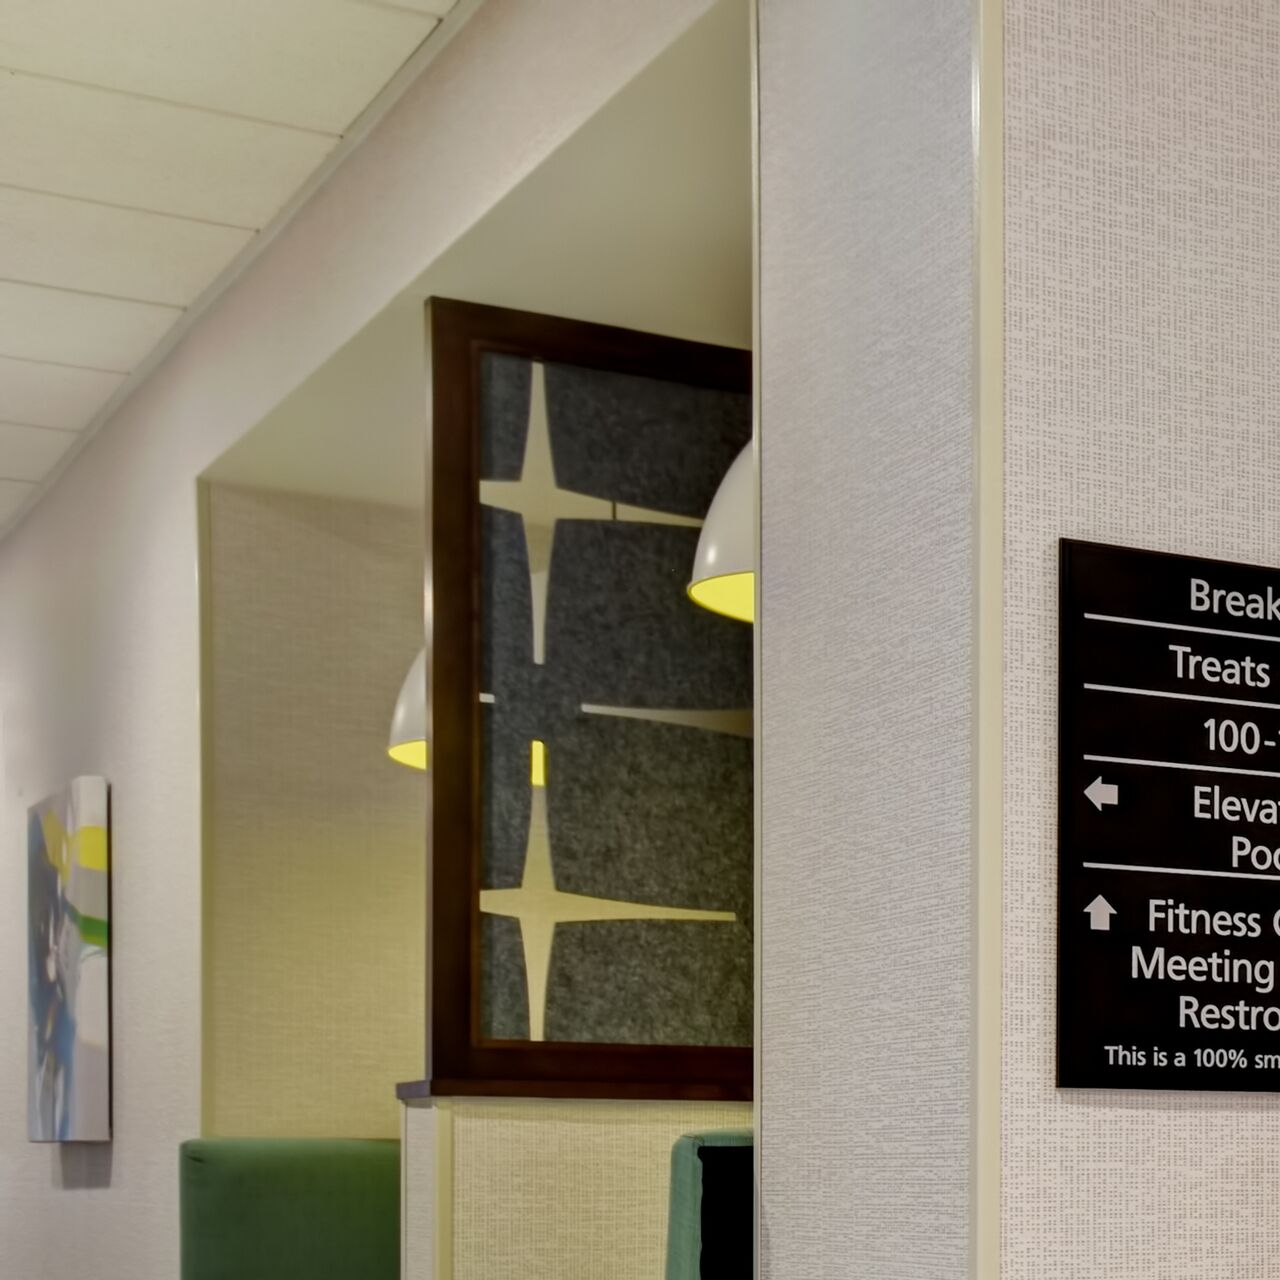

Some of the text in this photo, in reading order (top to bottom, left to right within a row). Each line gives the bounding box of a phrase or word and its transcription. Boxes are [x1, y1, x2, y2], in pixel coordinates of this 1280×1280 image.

[1168, 644, 1271, 689] Treats
[1148, 899, 1261, 938] Fitness
[1131, 945, 1275, 994] Meeting
[1104, 1044, 1147, 1066] This
[1153, 1046, 1168, 1067] is
[1173, 1052, 1186, 1067] a
[1193, 1048, 1248, 1069] 100%
